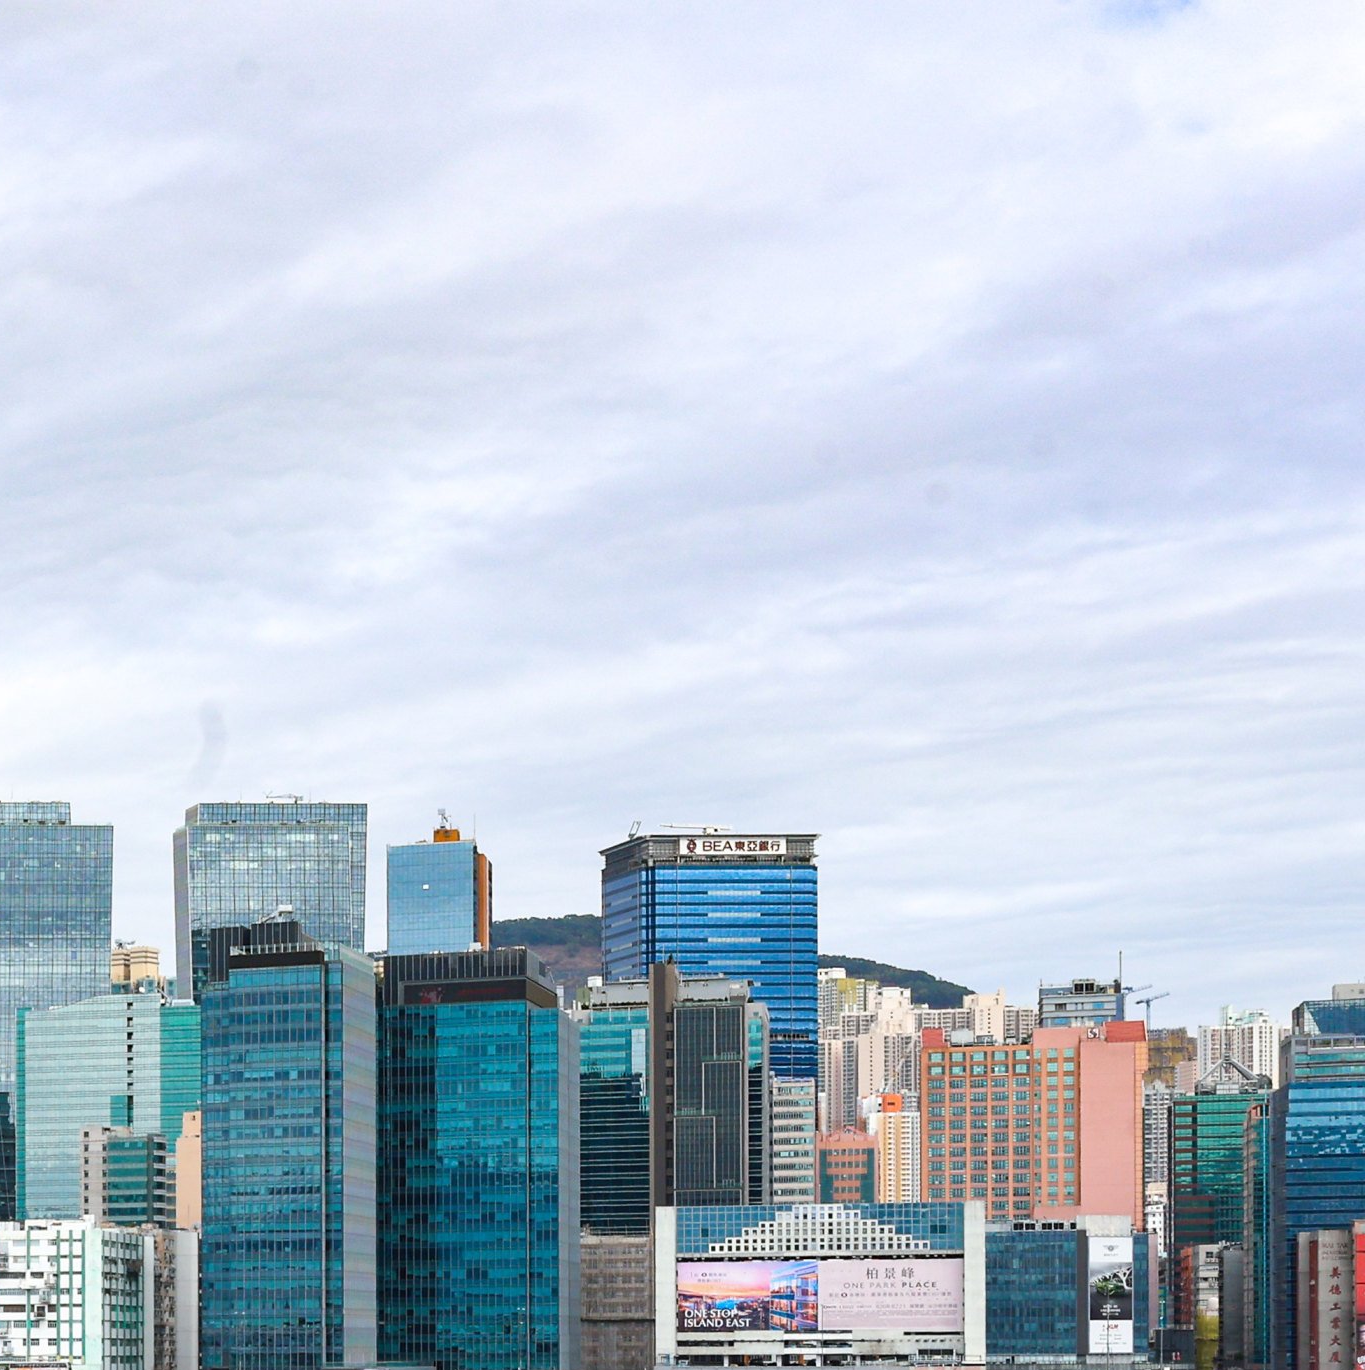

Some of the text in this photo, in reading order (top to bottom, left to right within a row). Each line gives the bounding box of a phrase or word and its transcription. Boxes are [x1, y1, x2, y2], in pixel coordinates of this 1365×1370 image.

[702, 841, 733, 852] BEA
[735, 841, 781, 852] 東亞銀行
[866, 1267, 915, 1280] 柏景峰
[684, 1309, 736, 1319] ONE STOP
[684, 1319, 751, 1327] ISLAND EAST
